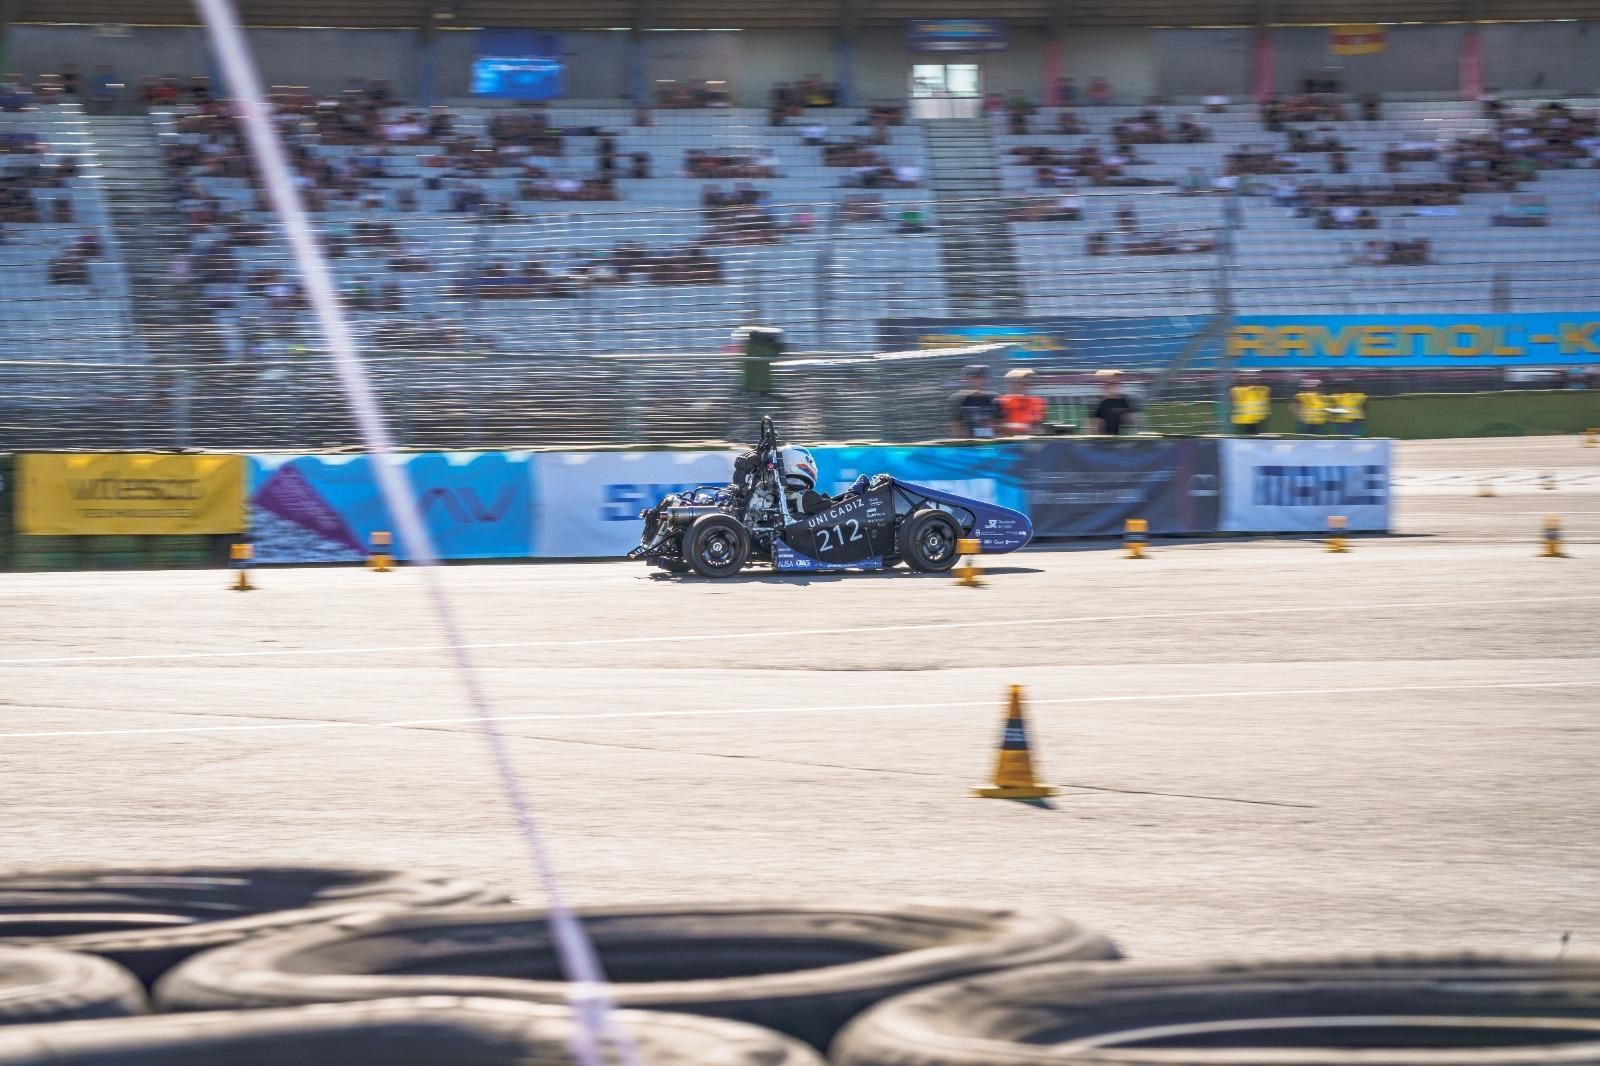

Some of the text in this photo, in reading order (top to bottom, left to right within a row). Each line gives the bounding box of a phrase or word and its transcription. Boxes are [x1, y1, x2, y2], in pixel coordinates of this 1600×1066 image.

[808, 498, 865, 528] UNI CADIZ
[816, 518, 864, 552] 212
